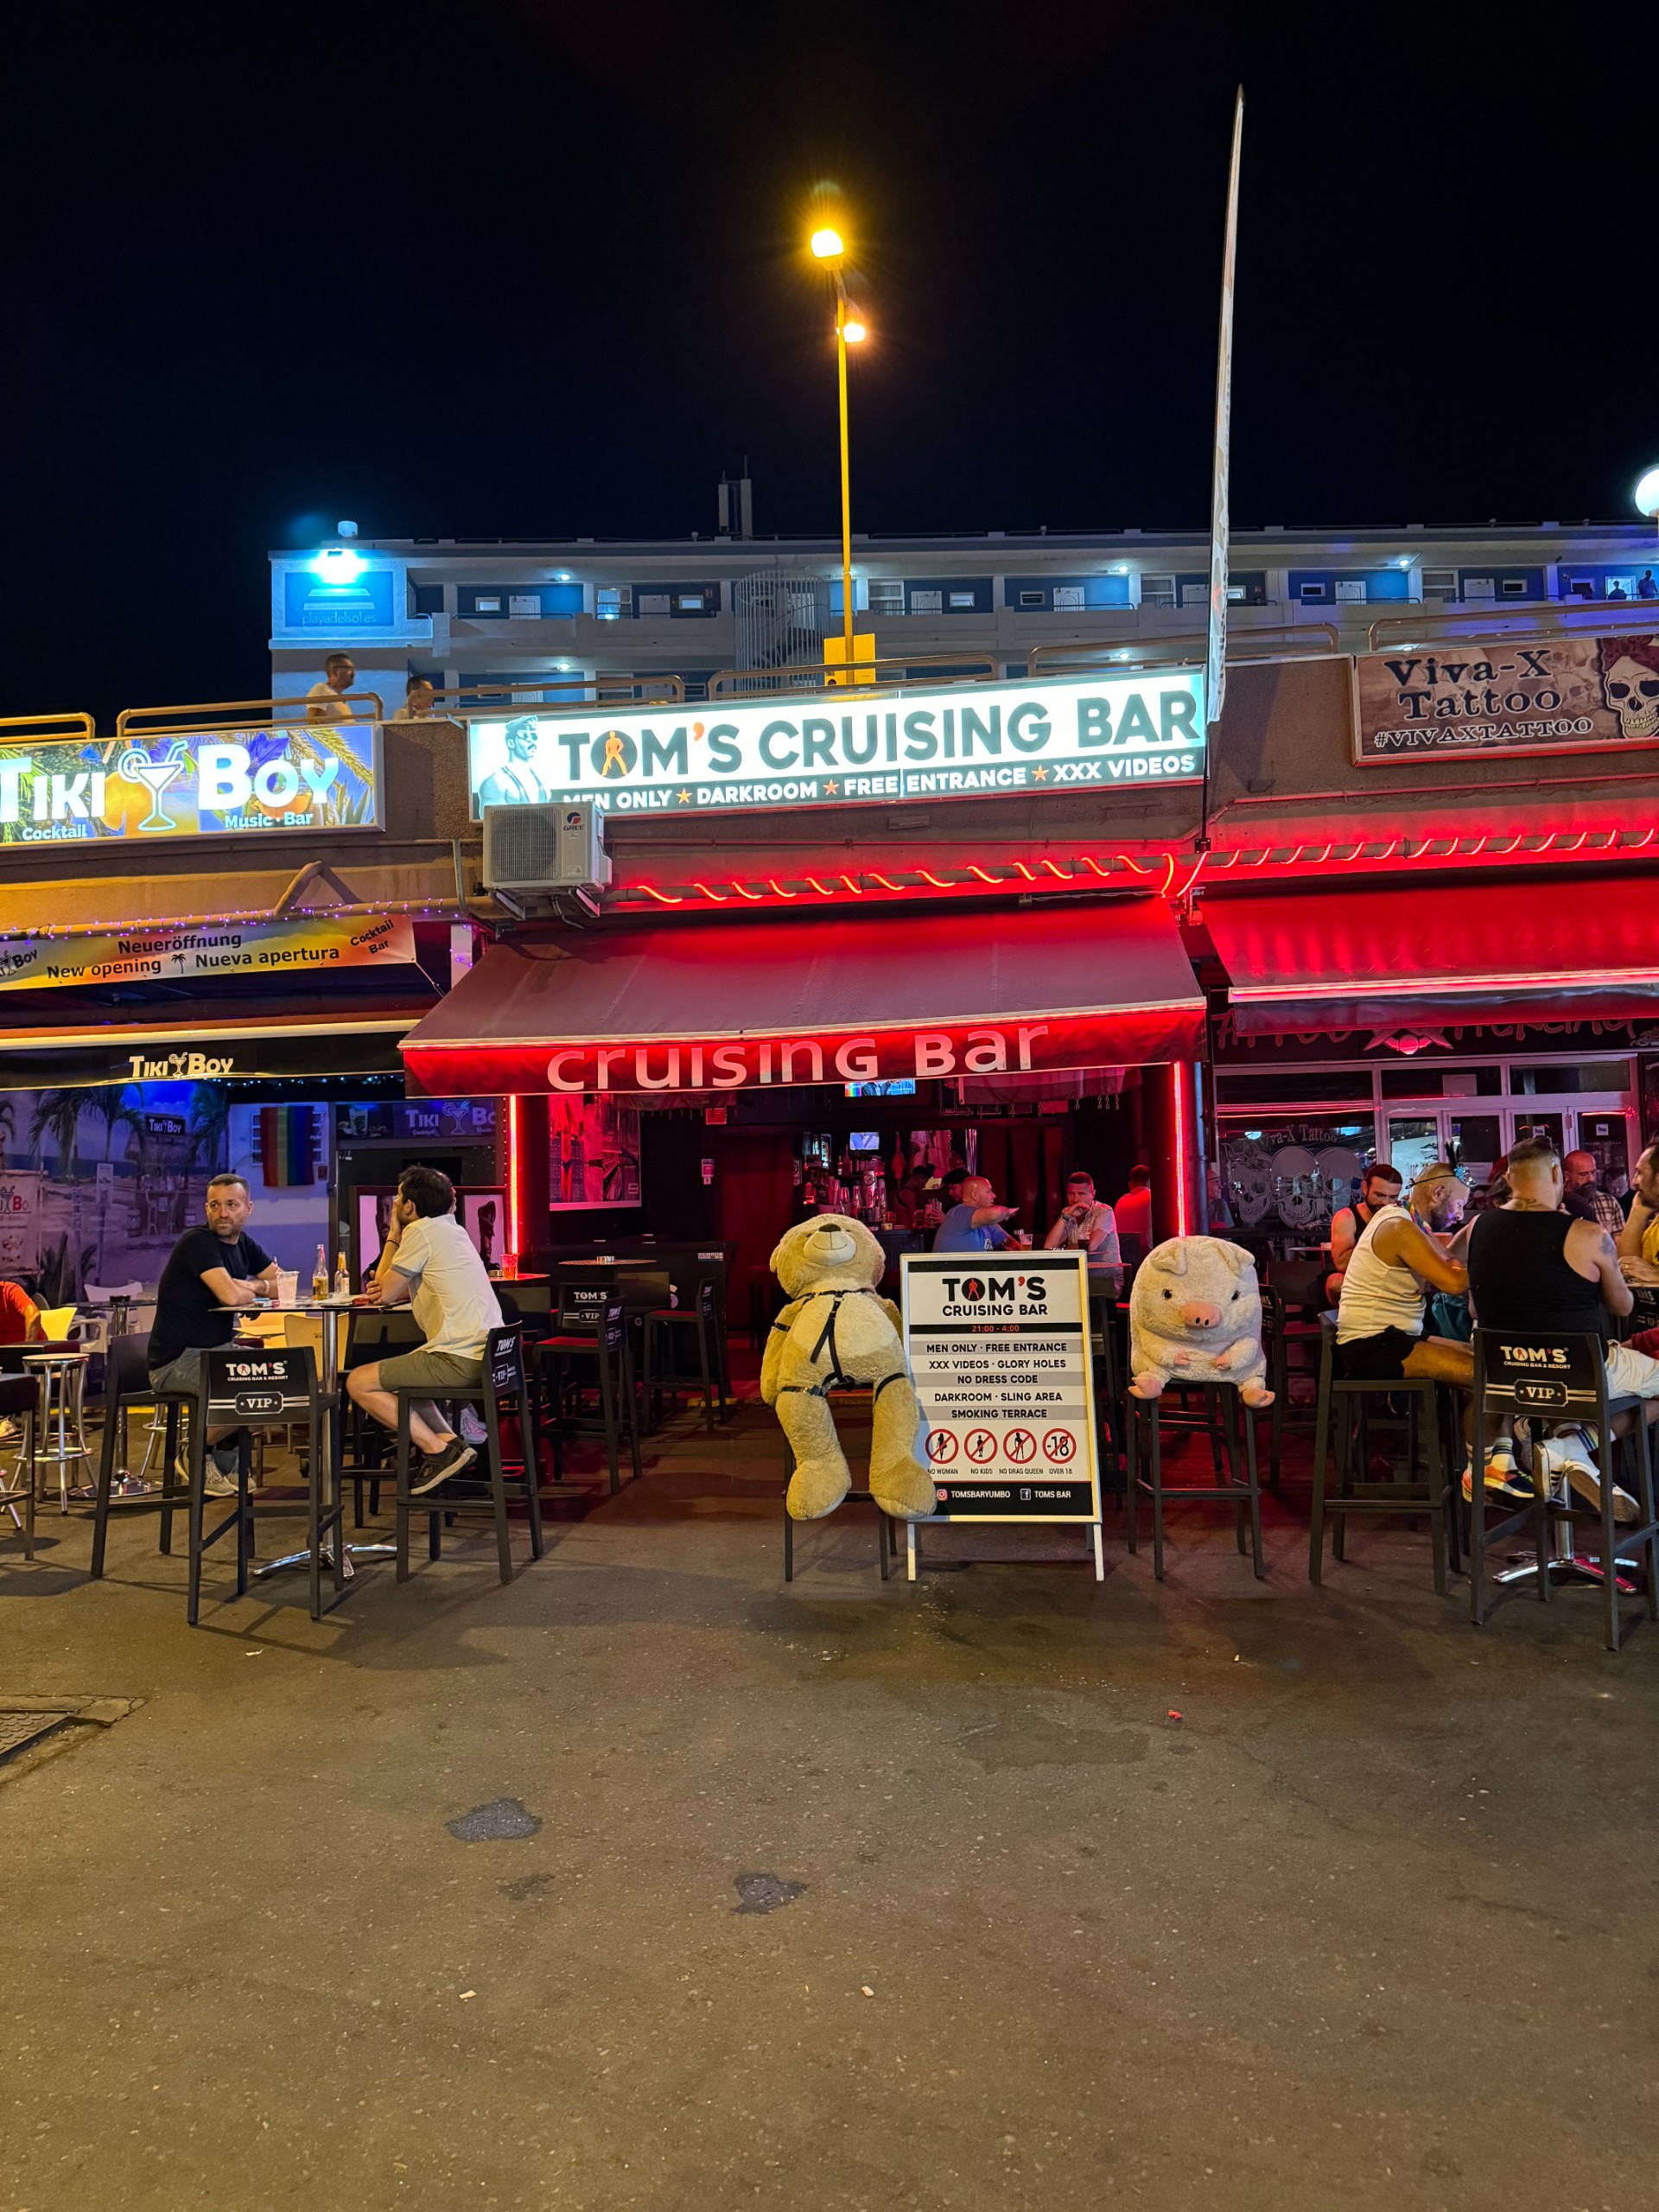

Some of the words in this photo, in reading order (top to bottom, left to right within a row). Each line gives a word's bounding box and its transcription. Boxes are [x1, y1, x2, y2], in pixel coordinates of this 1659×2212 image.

[1383, 650, 1552, 687] Viva-X
[1399, 688, 1561, 720] Tattoo
[558, 721, 742, 780] TOM'S
[759, 702, 1052, 770] CRUISING
[1077, 690, 1200, 748] BAR
[1374, 718, 1593, 747] #VIVAXTATTOO
[616, 790, 672, 808] ONLY
[697, 782, 817, 804] DARKROOM
[844, 777, 898, 796] FREE
[906, 767, 1027, 792] ENTRANCE
[1053, 761, 1102, 783] XXX
[1107, 754, 1194, 778] VIDEOS
[225, 814, 272, 830] Music
[284, 811, 313, 826] Bar
[22, 823, 87, 841] Cocktail
[350, 919, 394, 946] Cocktail
[118, 933, 242, 954] Neueröffnung
[369, 940, 389, 954] Bar
[47, 965, 86, 978] New
[91, 959, 162, 978] opening
[195, 951, 252, 968] Nueva
[259, 946, 340, 967] apertura
[942, 1275, 1046, 1302] TOM'S
[943, 1304, 1014, 1316] CRUISING
[1020, 1304, 1048, 1315] BAR
[926, 1344, 949, 1353] MEN
[951, 1344, 977, 1352] ONLY
[985, 1344, 1010, 1352] FREE
[1014, 1343, 1067, 1351] ENTRANCE
[1500, 1345, 1567, 1363] TOM'S
[226, 1362, 285, 1376] TOM'S
[929, 1361, 950, 1370] XXX
[952, 1360, 989, 1369] VIDEOS
[1033, 1359, 1066, 1368] HOLES
[1010, 1375, 1039, 1383] CODE
[934, 1393, 992, 1402] DARKROOM
[1525, 1386, 1555, 1399] VIP
[245, 1397, 273, 1408] VIP
[951, 1409, 999, 1418] SMOKING
[1001, 1409, 1047, 1418] TERRACE
